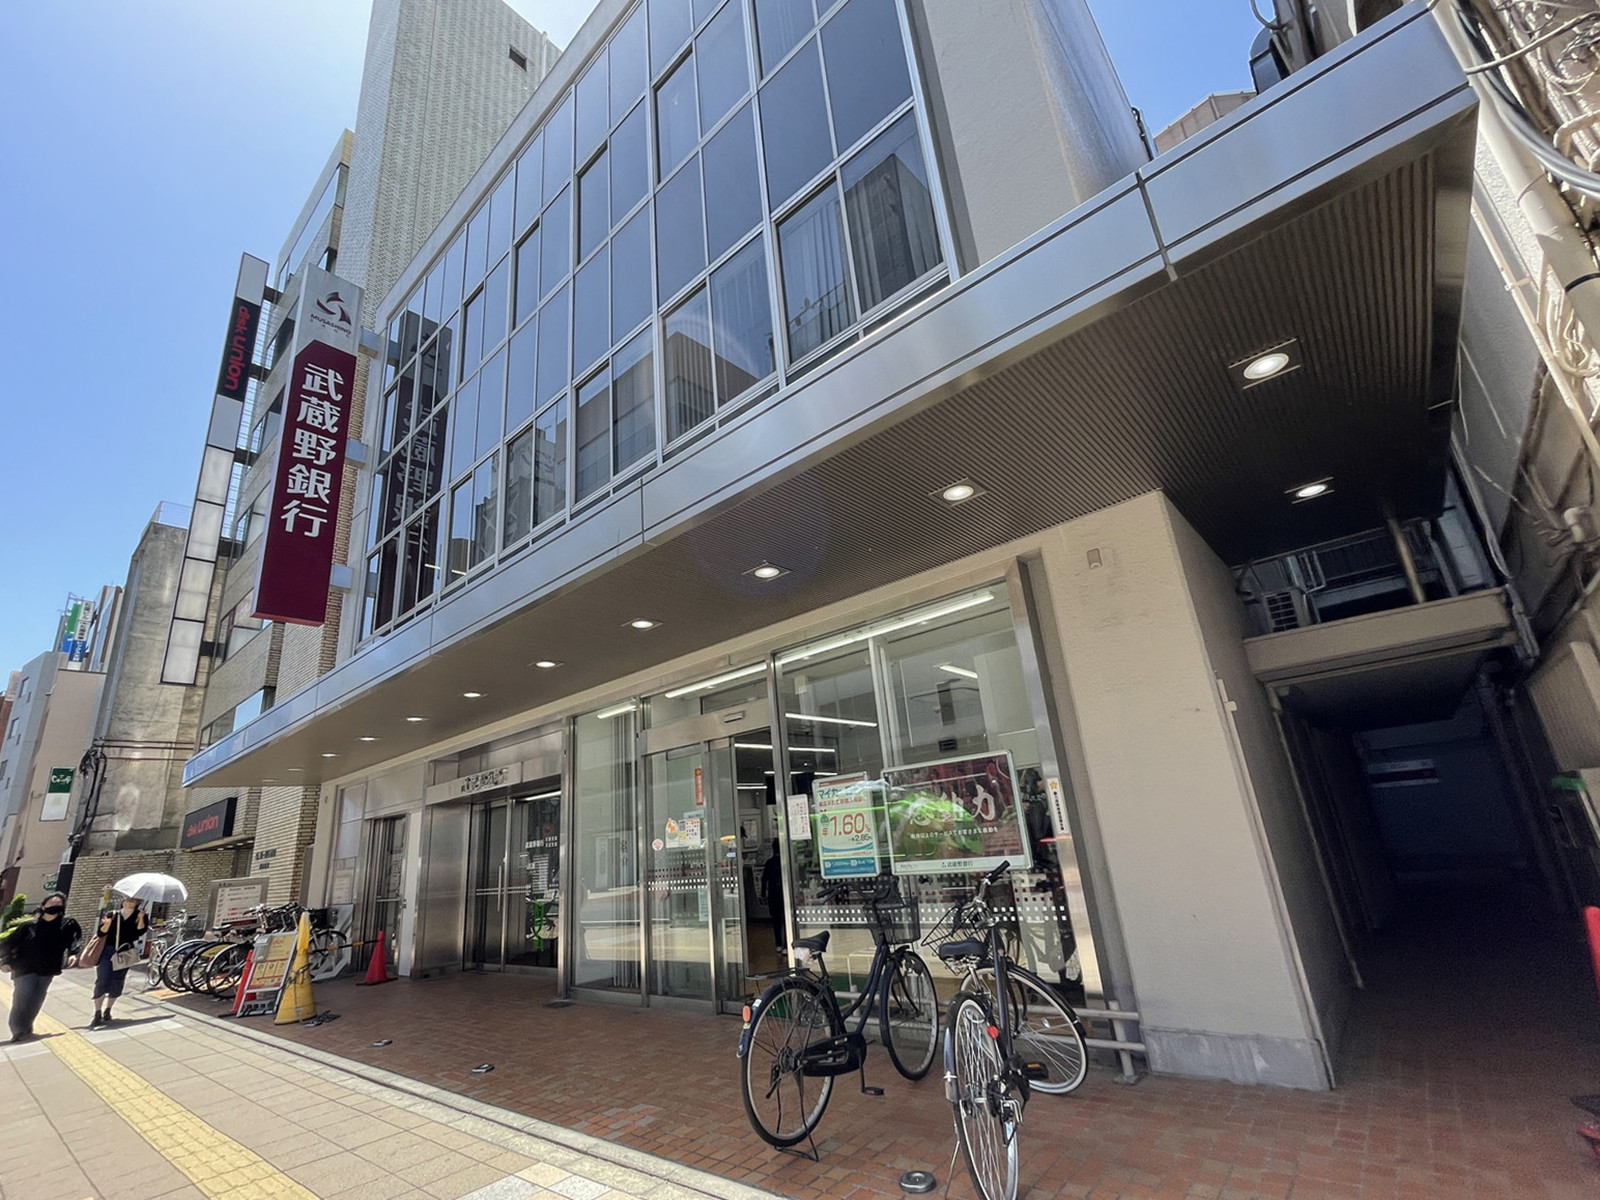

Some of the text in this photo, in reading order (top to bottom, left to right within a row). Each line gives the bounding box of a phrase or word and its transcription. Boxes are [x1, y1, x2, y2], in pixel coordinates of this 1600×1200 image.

[310, 313, 352, 335] MUSASHINO
[224, 336, 247, 391] union
[281, 362, 344, 538] 武蔵野銀行
